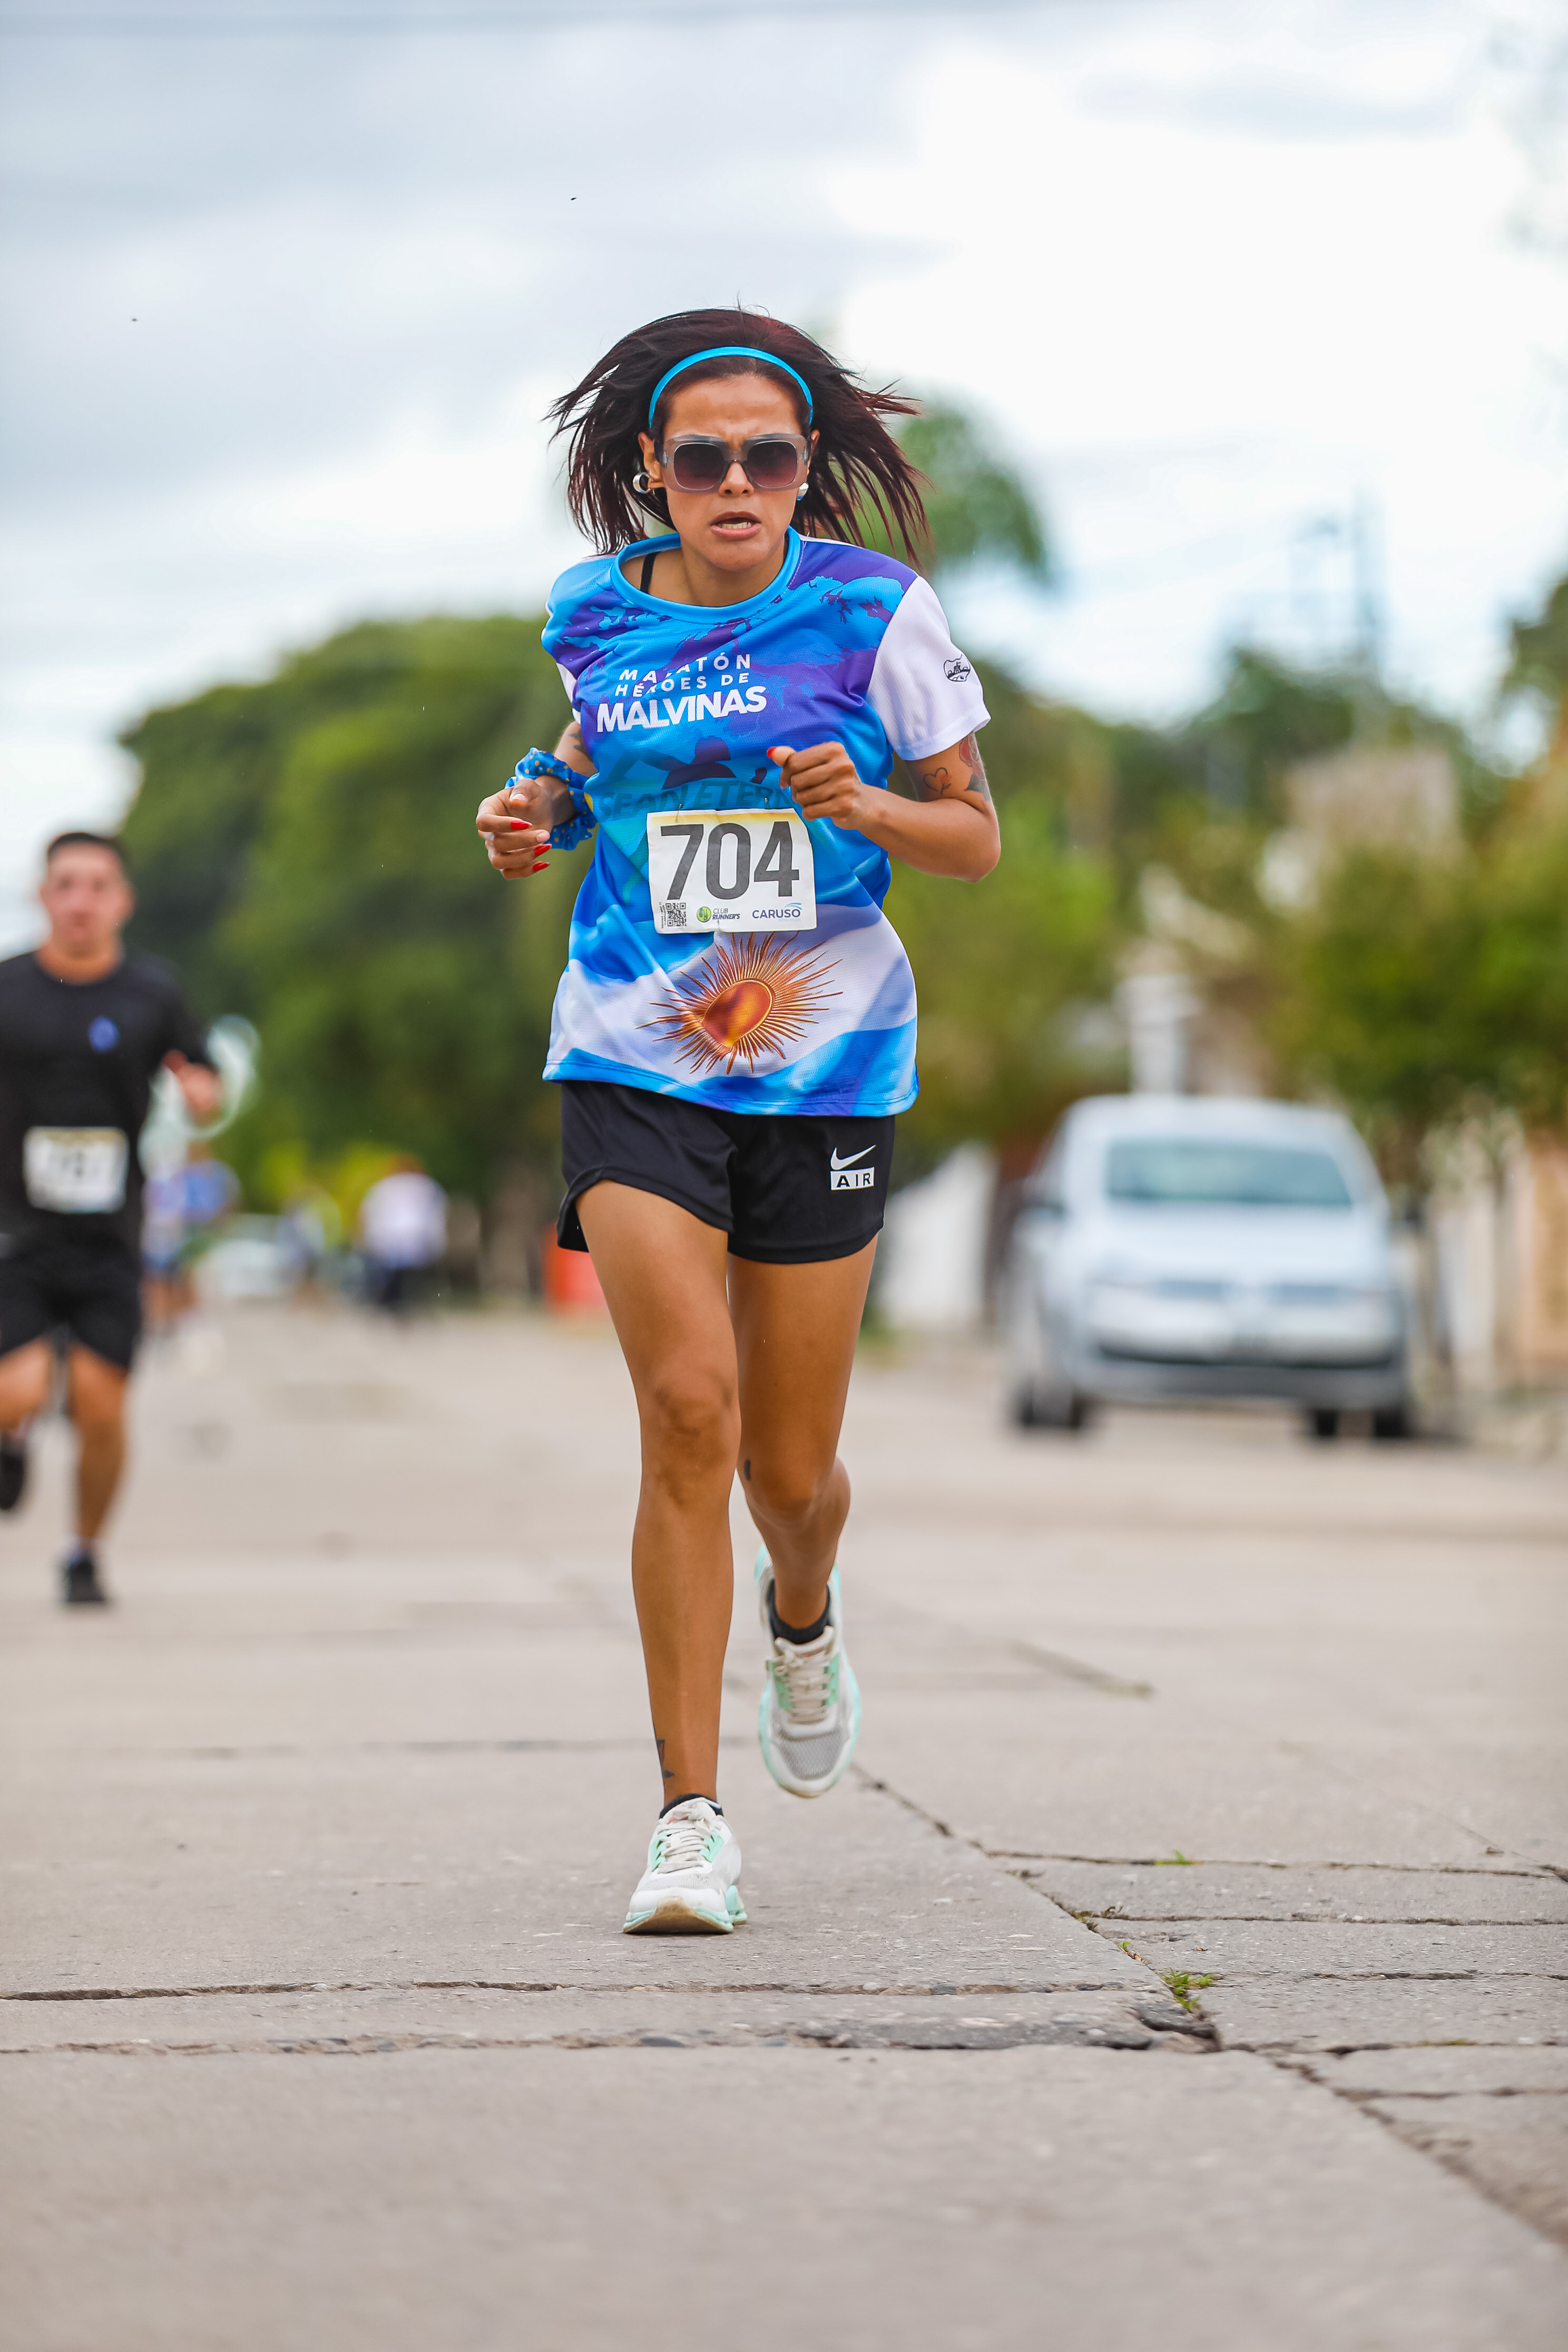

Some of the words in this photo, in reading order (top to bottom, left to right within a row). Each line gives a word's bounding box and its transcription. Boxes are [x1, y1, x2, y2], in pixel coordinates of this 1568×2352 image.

[619, 652, 750, 683] MAATÓN
[721, 672, 749, 686] DE
[597, 685, 767, 732] MALVINAS
[692, 780, 796, 809] ETERN
[661, 821, 800, 900] 704
[752, 908, 801, 918] CARUSO
[836, 1172, 871, 1188] AIR
